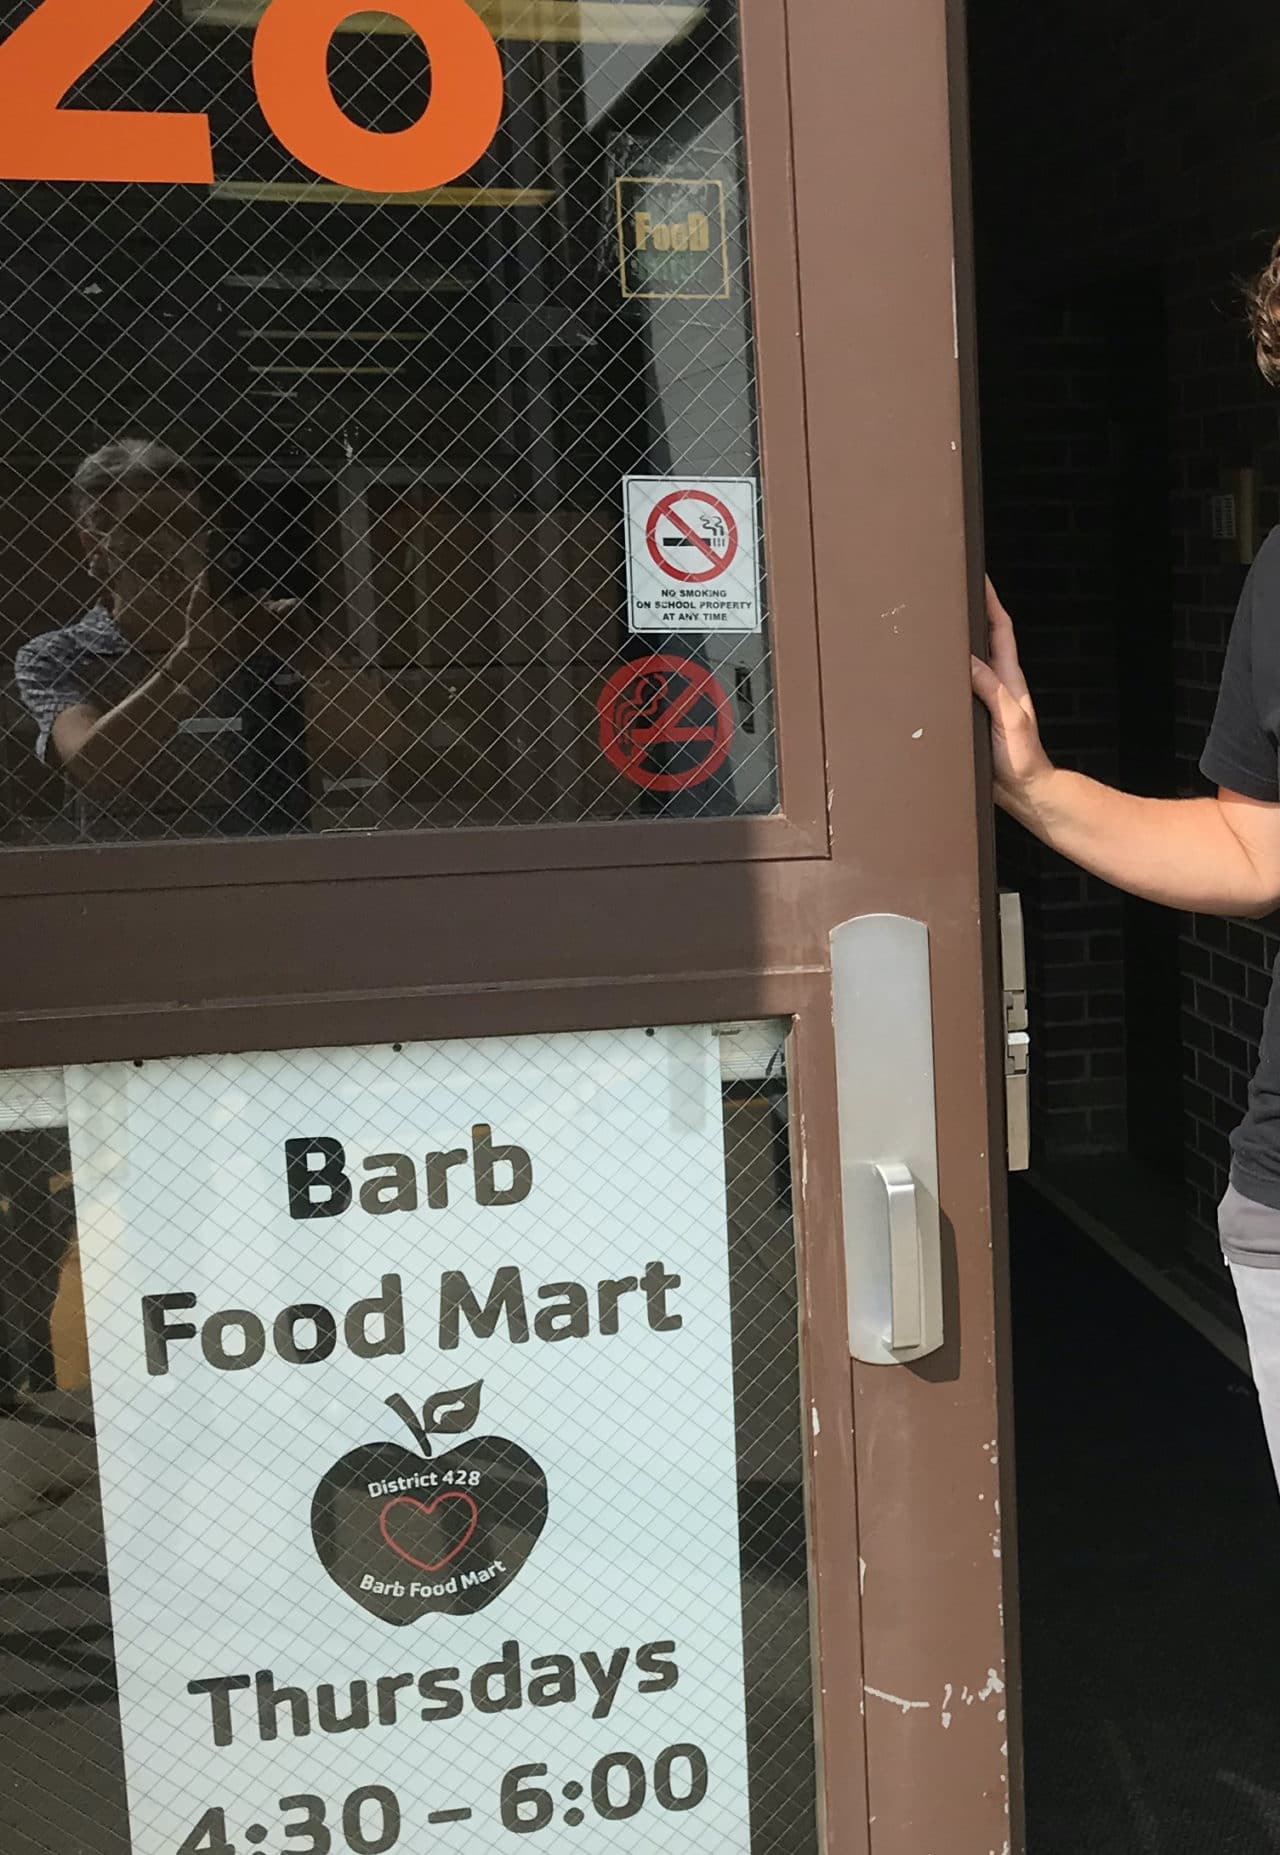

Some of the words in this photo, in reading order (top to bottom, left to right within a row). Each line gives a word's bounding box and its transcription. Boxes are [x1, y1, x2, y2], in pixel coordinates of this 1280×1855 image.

[636, 601, 651, 609] ON
[655, 601, 696, 609] SCHOOL
[699, 601, 752, 609] PROPERTY
[661, 589, 676, 598] NO
[679, 589, 727, 598] SMOKING
[662, 613, 675, 621] AT
[678, 613, 699, 621] ANY
[703, 613, 727, 621] TIME
[285, 1123, 533, 1220] Barb
[142, 1272, 405, 1377] Food
[438, 1261, 682, 1350] Mart
[367, 1471, 438, 1498] District
[442, 1470, 481, 1487] 428
[359, 1574, 405, 1597] Barb
[409, 1577, 458, 1598] Food
[461, 1560, 507, 1590] Mart
[187, 1640, 679, 1747] Thursdays
[500, 1743, 709, 1834] 6:00
